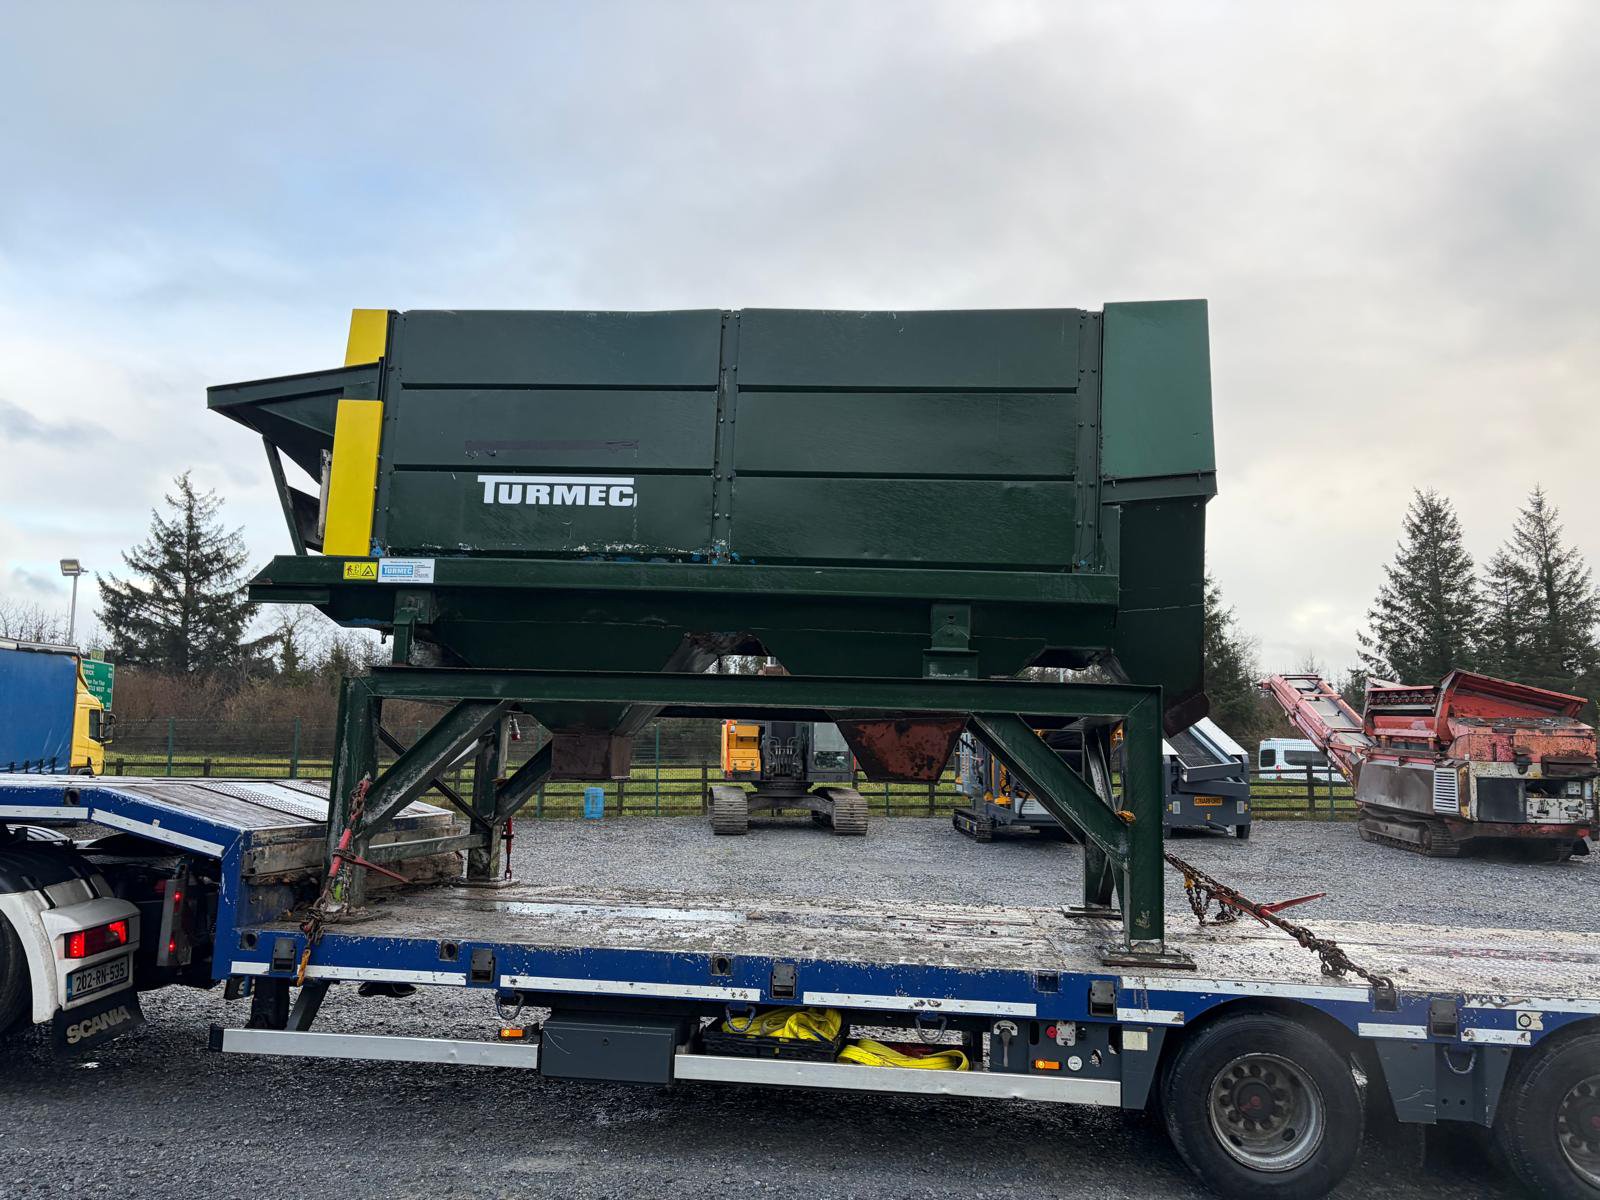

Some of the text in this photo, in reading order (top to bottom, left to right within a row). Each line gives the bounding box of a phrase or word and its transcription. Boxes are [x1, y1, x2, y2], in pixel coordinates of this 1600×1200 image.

[477, 474, 637, 507] TURMEC
[76, 962, 125, 992] 202-RN-535
[66, 1005, 131, 1044] SCANIA
